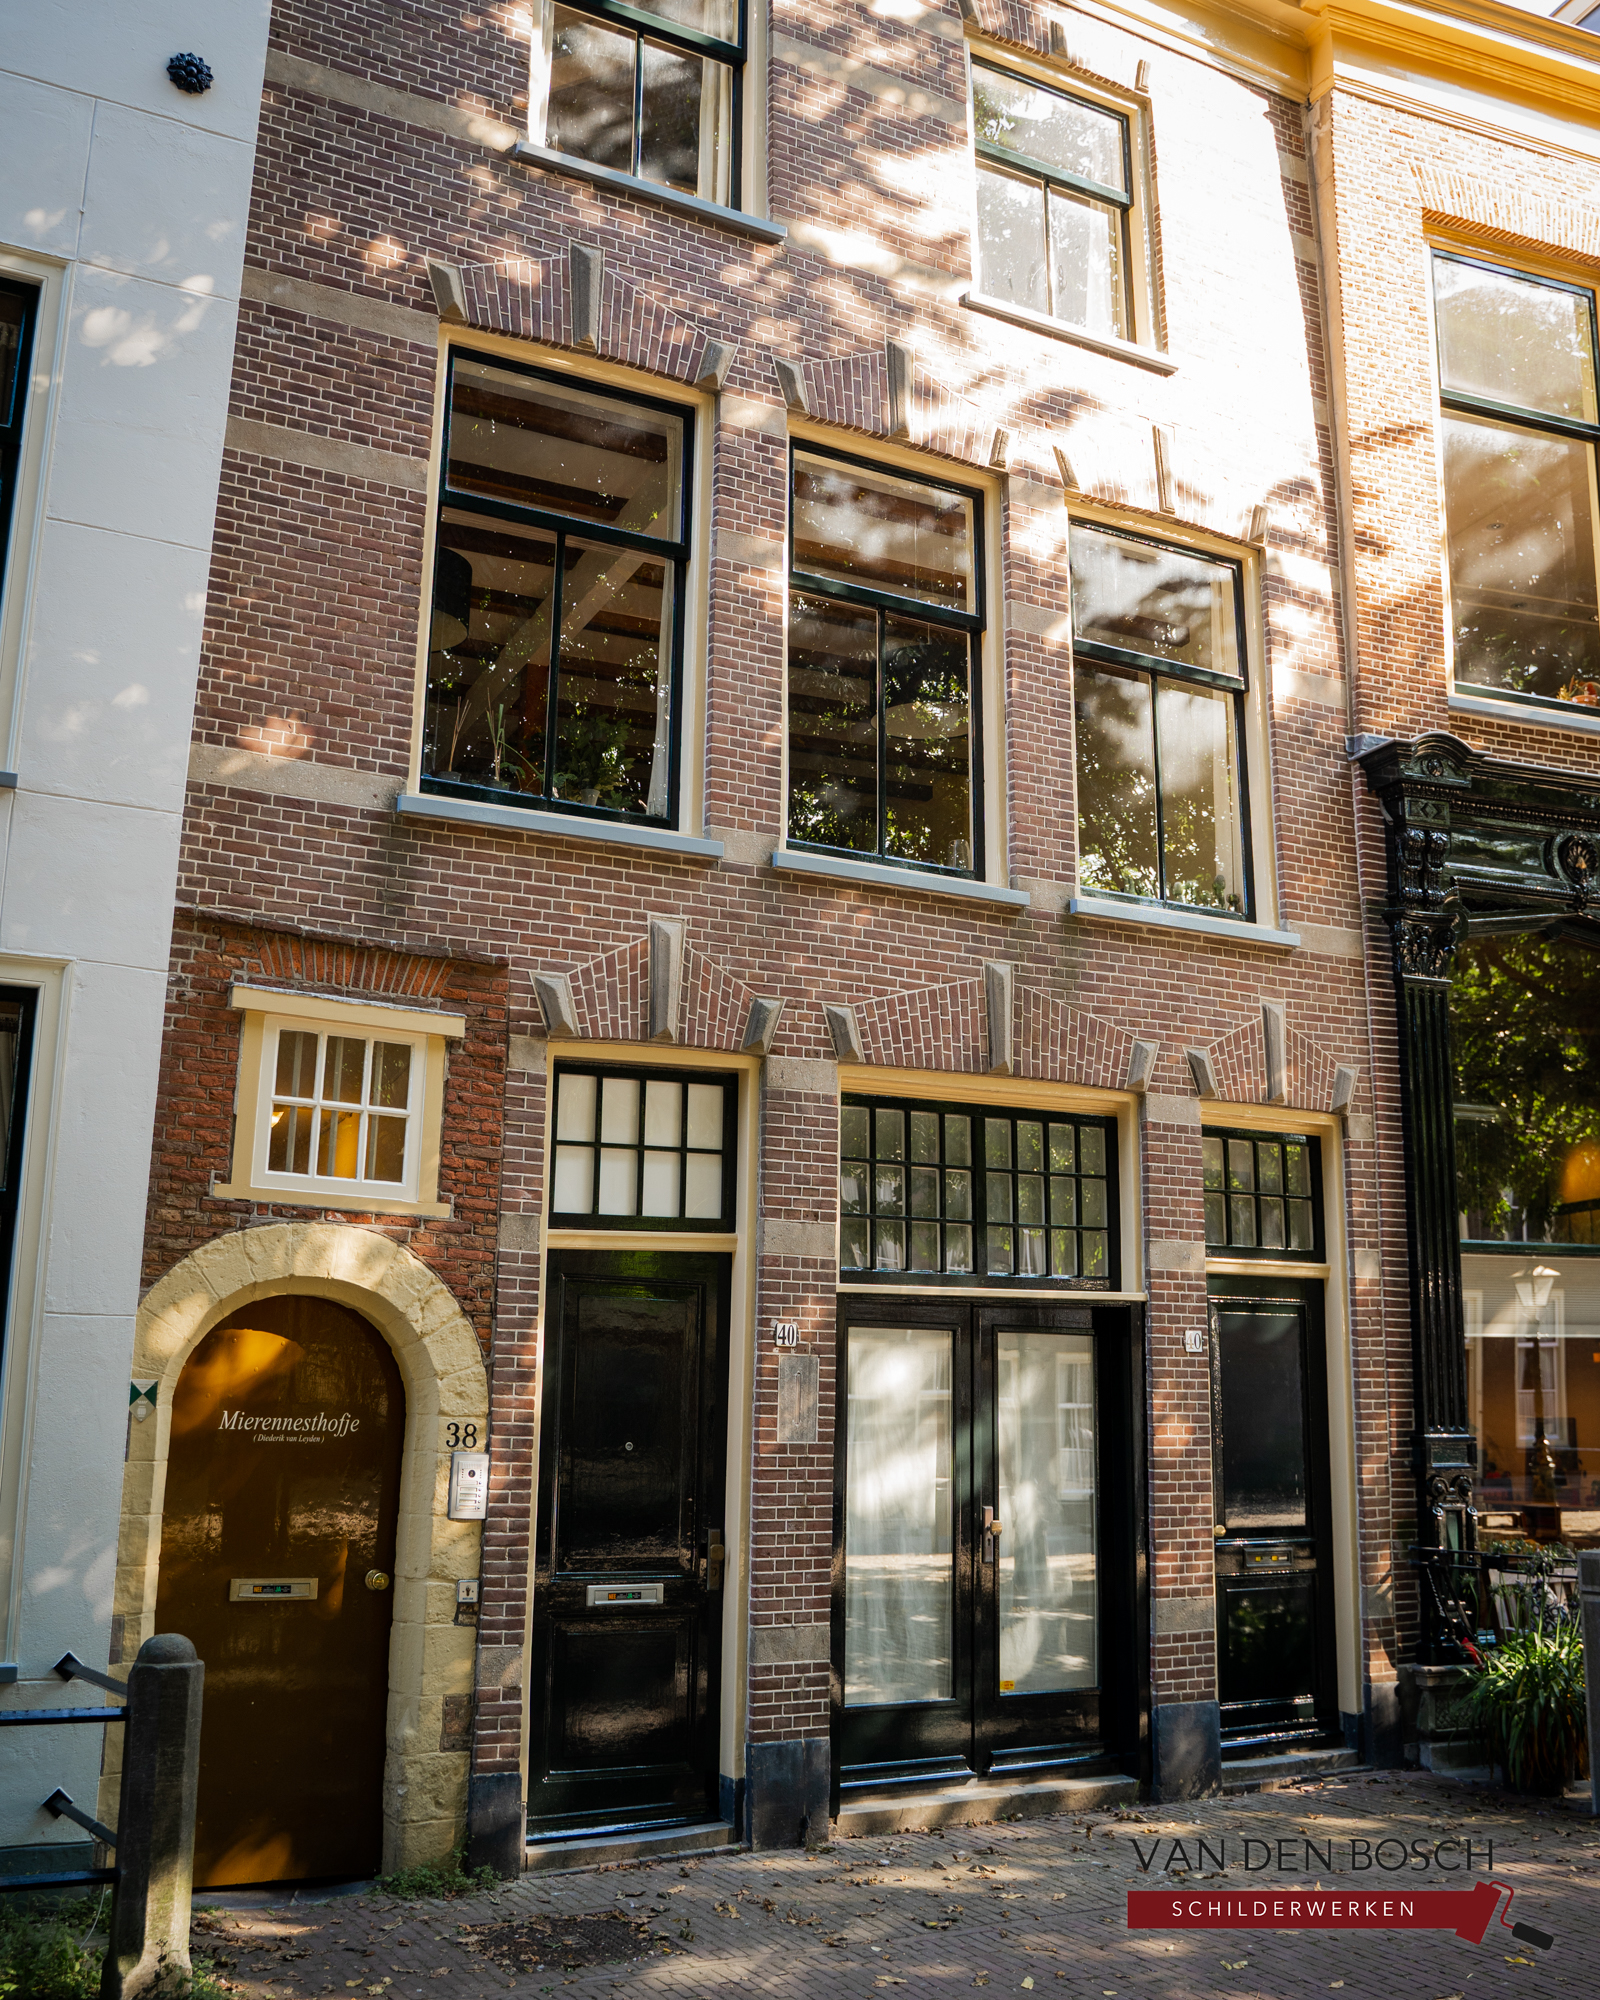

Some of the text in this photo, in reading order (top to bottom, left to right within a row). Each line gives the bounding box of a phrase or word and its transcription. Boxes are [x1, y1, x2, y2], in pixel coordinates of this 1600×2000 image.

[777, 1324, 795, 1346] 40
[1186, 1332, 1202, 1350] 40
[218, 1410, 360, 1437] Mierennesthofje
[446, 1422, 477, 1448] 38
